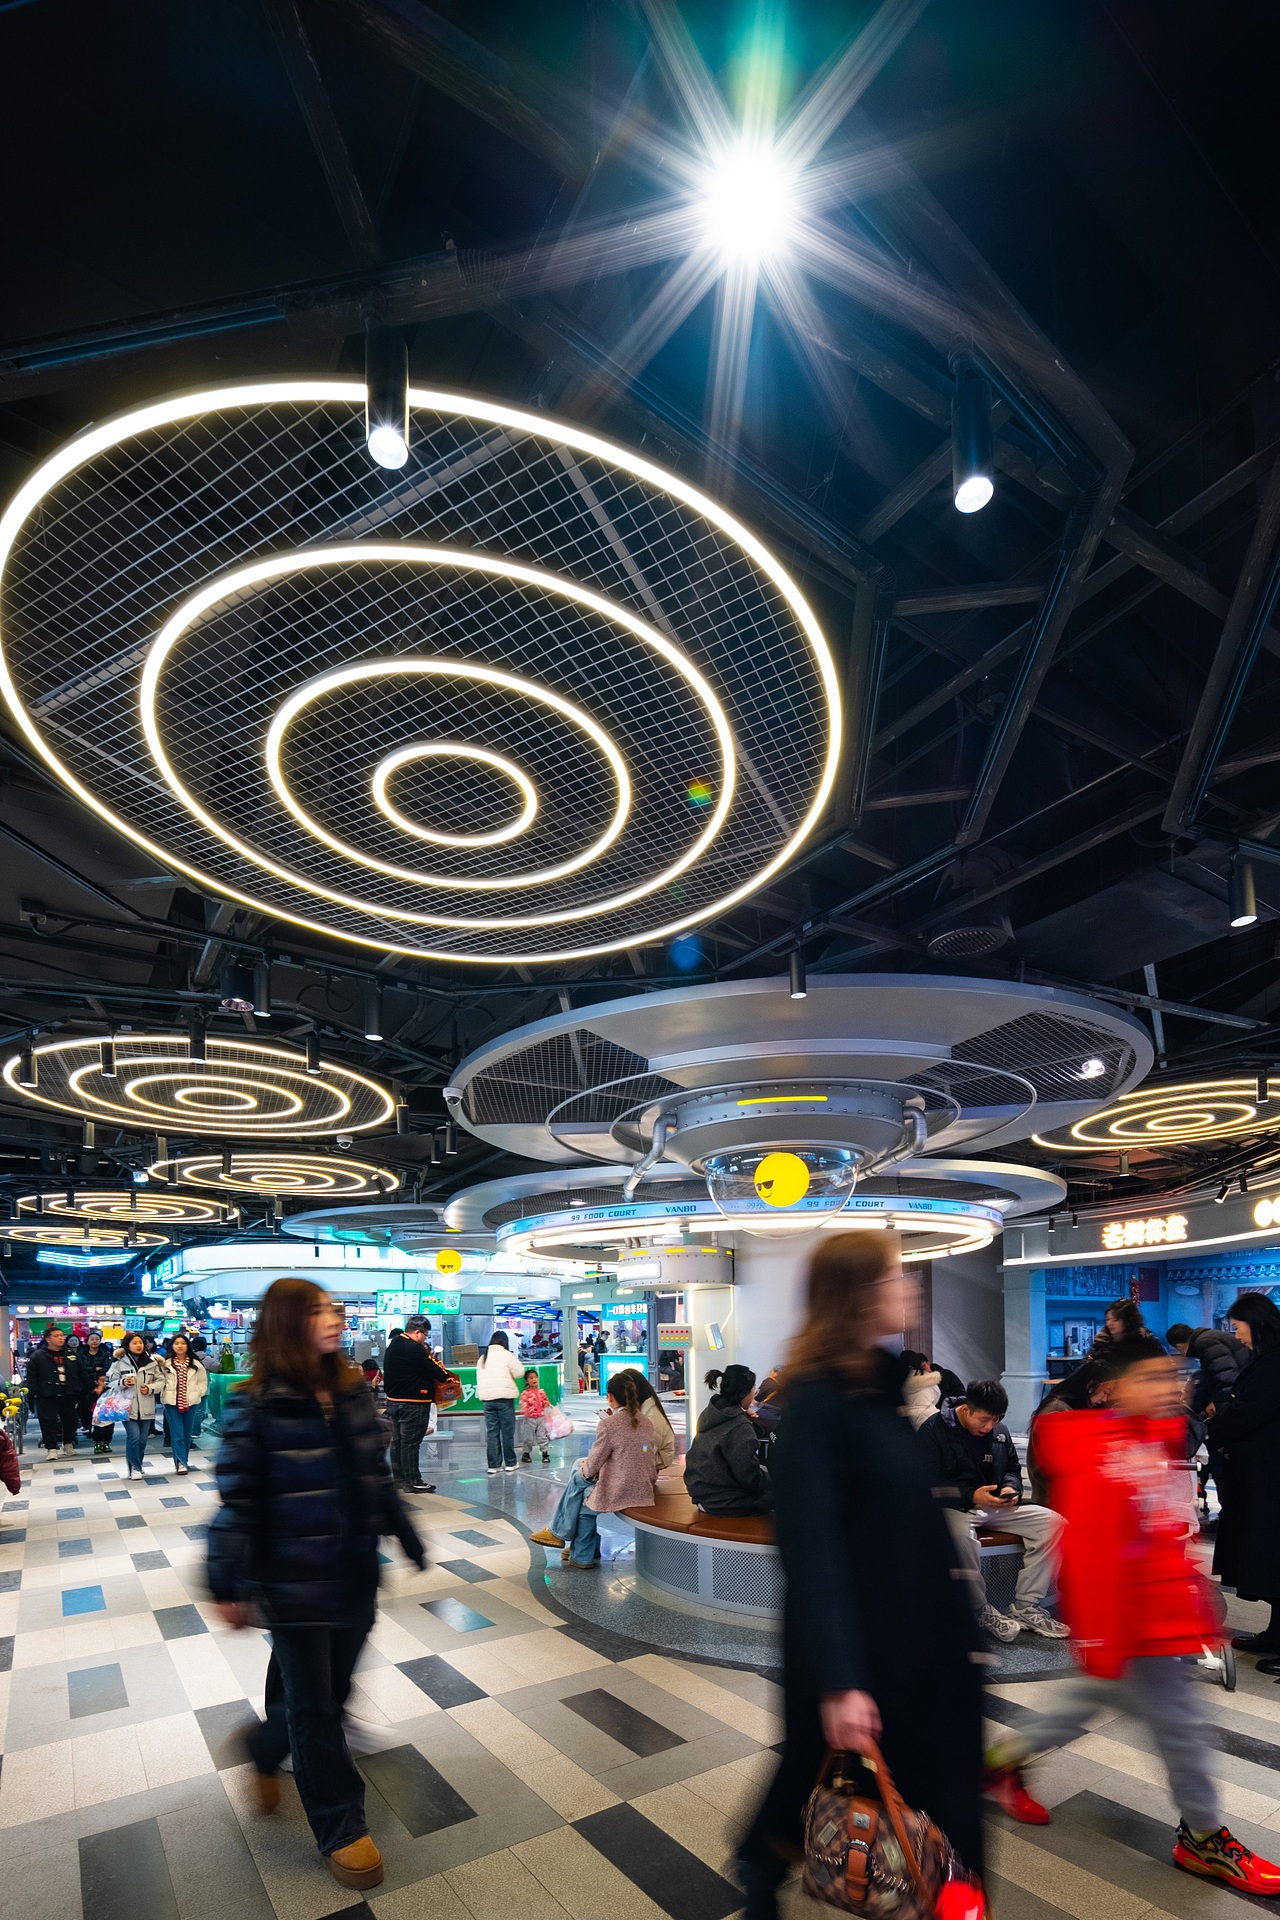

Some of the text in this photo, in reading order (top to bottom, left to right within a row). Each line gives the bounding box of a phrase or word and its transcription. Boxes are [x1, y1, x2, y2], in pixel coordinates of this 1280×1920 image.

[806, 1200, 820, 1208] 99
[855, 1200, 885, 1208] COURT
[571, 1209, 637, 1222] 99 FOOD COURT
